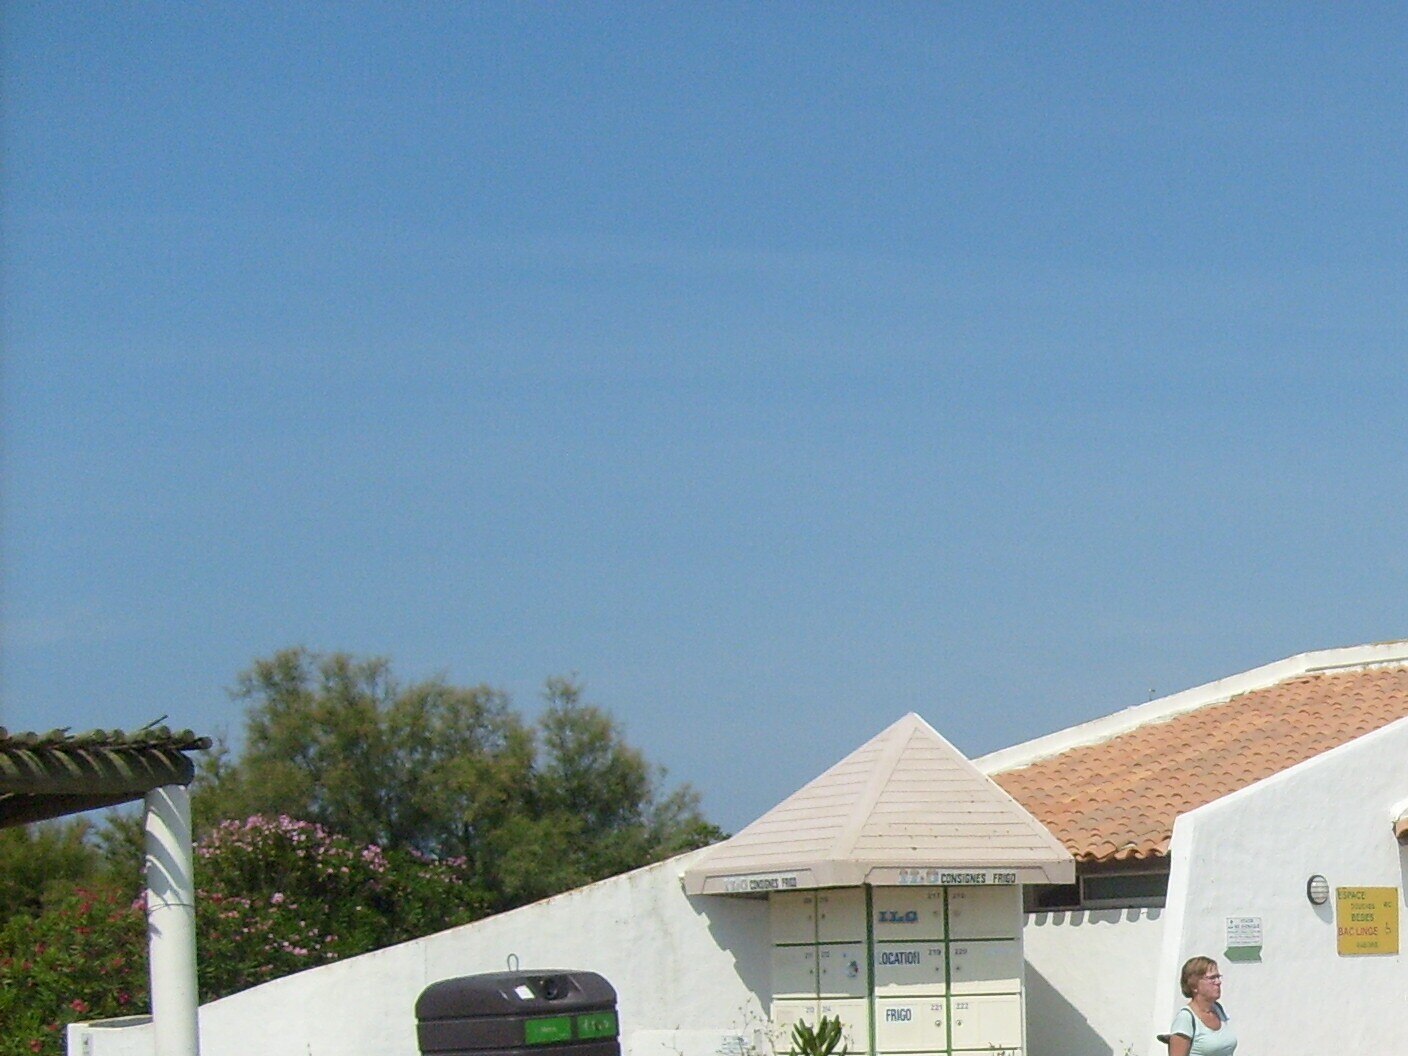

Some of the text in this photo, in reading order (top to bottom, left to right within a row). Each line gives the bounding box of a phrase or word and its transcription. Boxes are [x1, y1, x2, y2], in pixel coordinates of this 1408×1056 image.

[940, 872, 987, 884] CONSIGNES
[992, 872, 1017, 884] FRIGO
[879, 951, 921, 965] LOCATION
[885, 1008, 912, 1022] FRIGO
